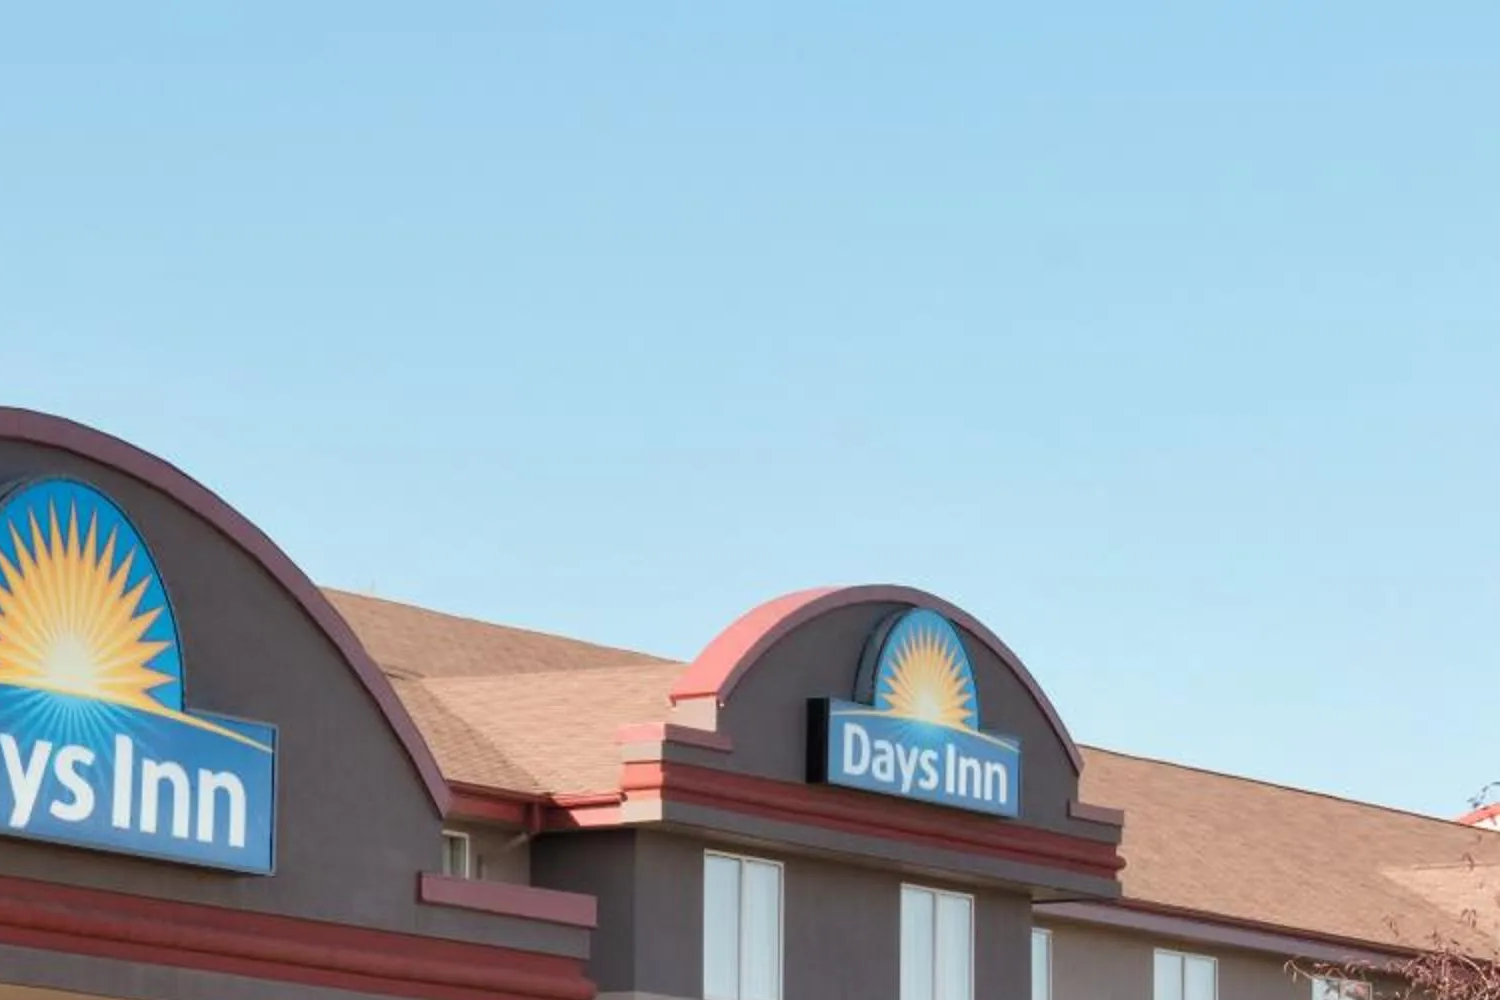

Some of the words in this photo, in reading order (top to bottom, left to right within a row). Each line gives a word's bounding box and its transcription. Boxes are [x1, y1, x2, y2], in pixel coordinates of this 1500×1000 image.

[111, 733, 246, 848] Inn
[843, 722, 939, 793] Days
[945, 743, 1008, 805] Inn
